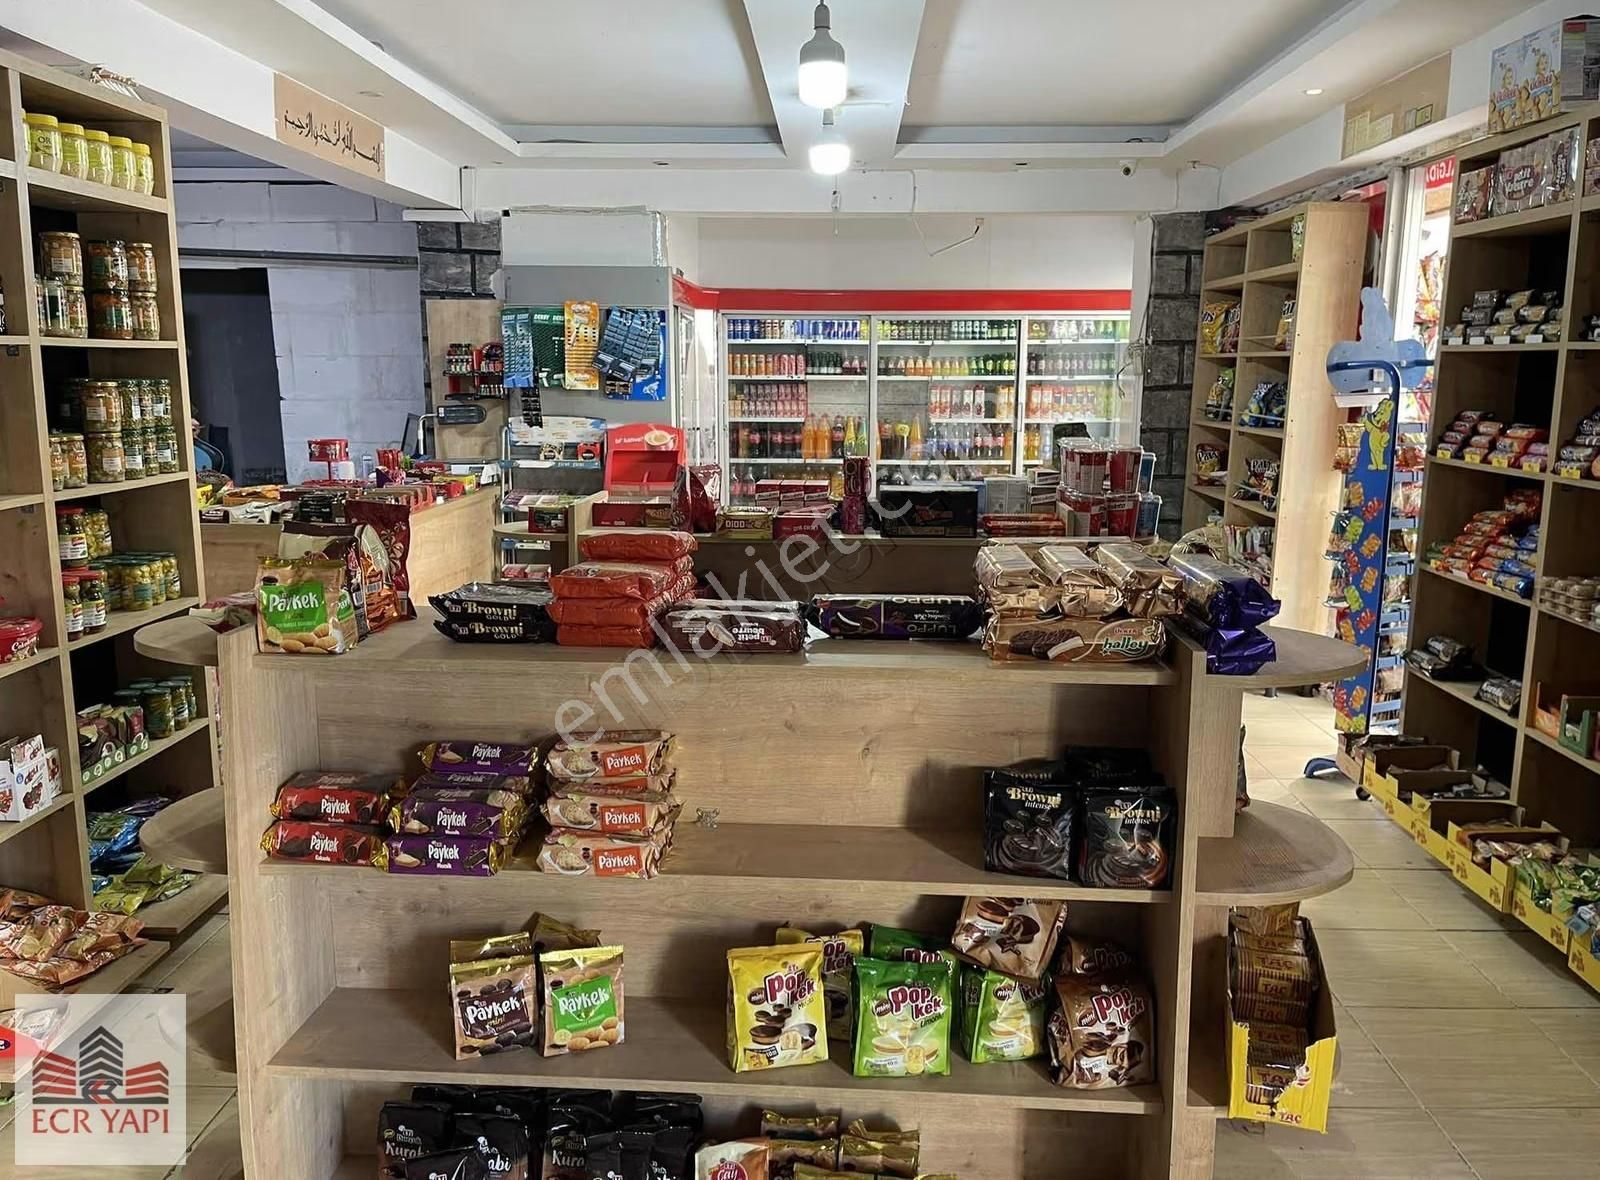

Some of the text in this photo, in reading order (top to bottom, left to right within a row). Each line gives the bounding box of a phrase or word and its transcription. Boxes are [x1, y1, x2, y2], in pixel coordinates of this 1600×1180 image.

[462, 601, 517, 620] Browni
[469, 622, 523, 636] Browni
[907, 623, 957, 636] LUPPO
[1102, 636, 1150, 652] halley
[472, 744, 501, 760] Paykek
[1006, 787, 1062, 808] Browni
[321, 798, 351, 817] Paykek
[1104, 804, 1162, 823] Browni
[436, 810, 468, 830] Paykek
[310, 834, 340, 855] Paykek
[428, 844, 459, 863] Paykek
